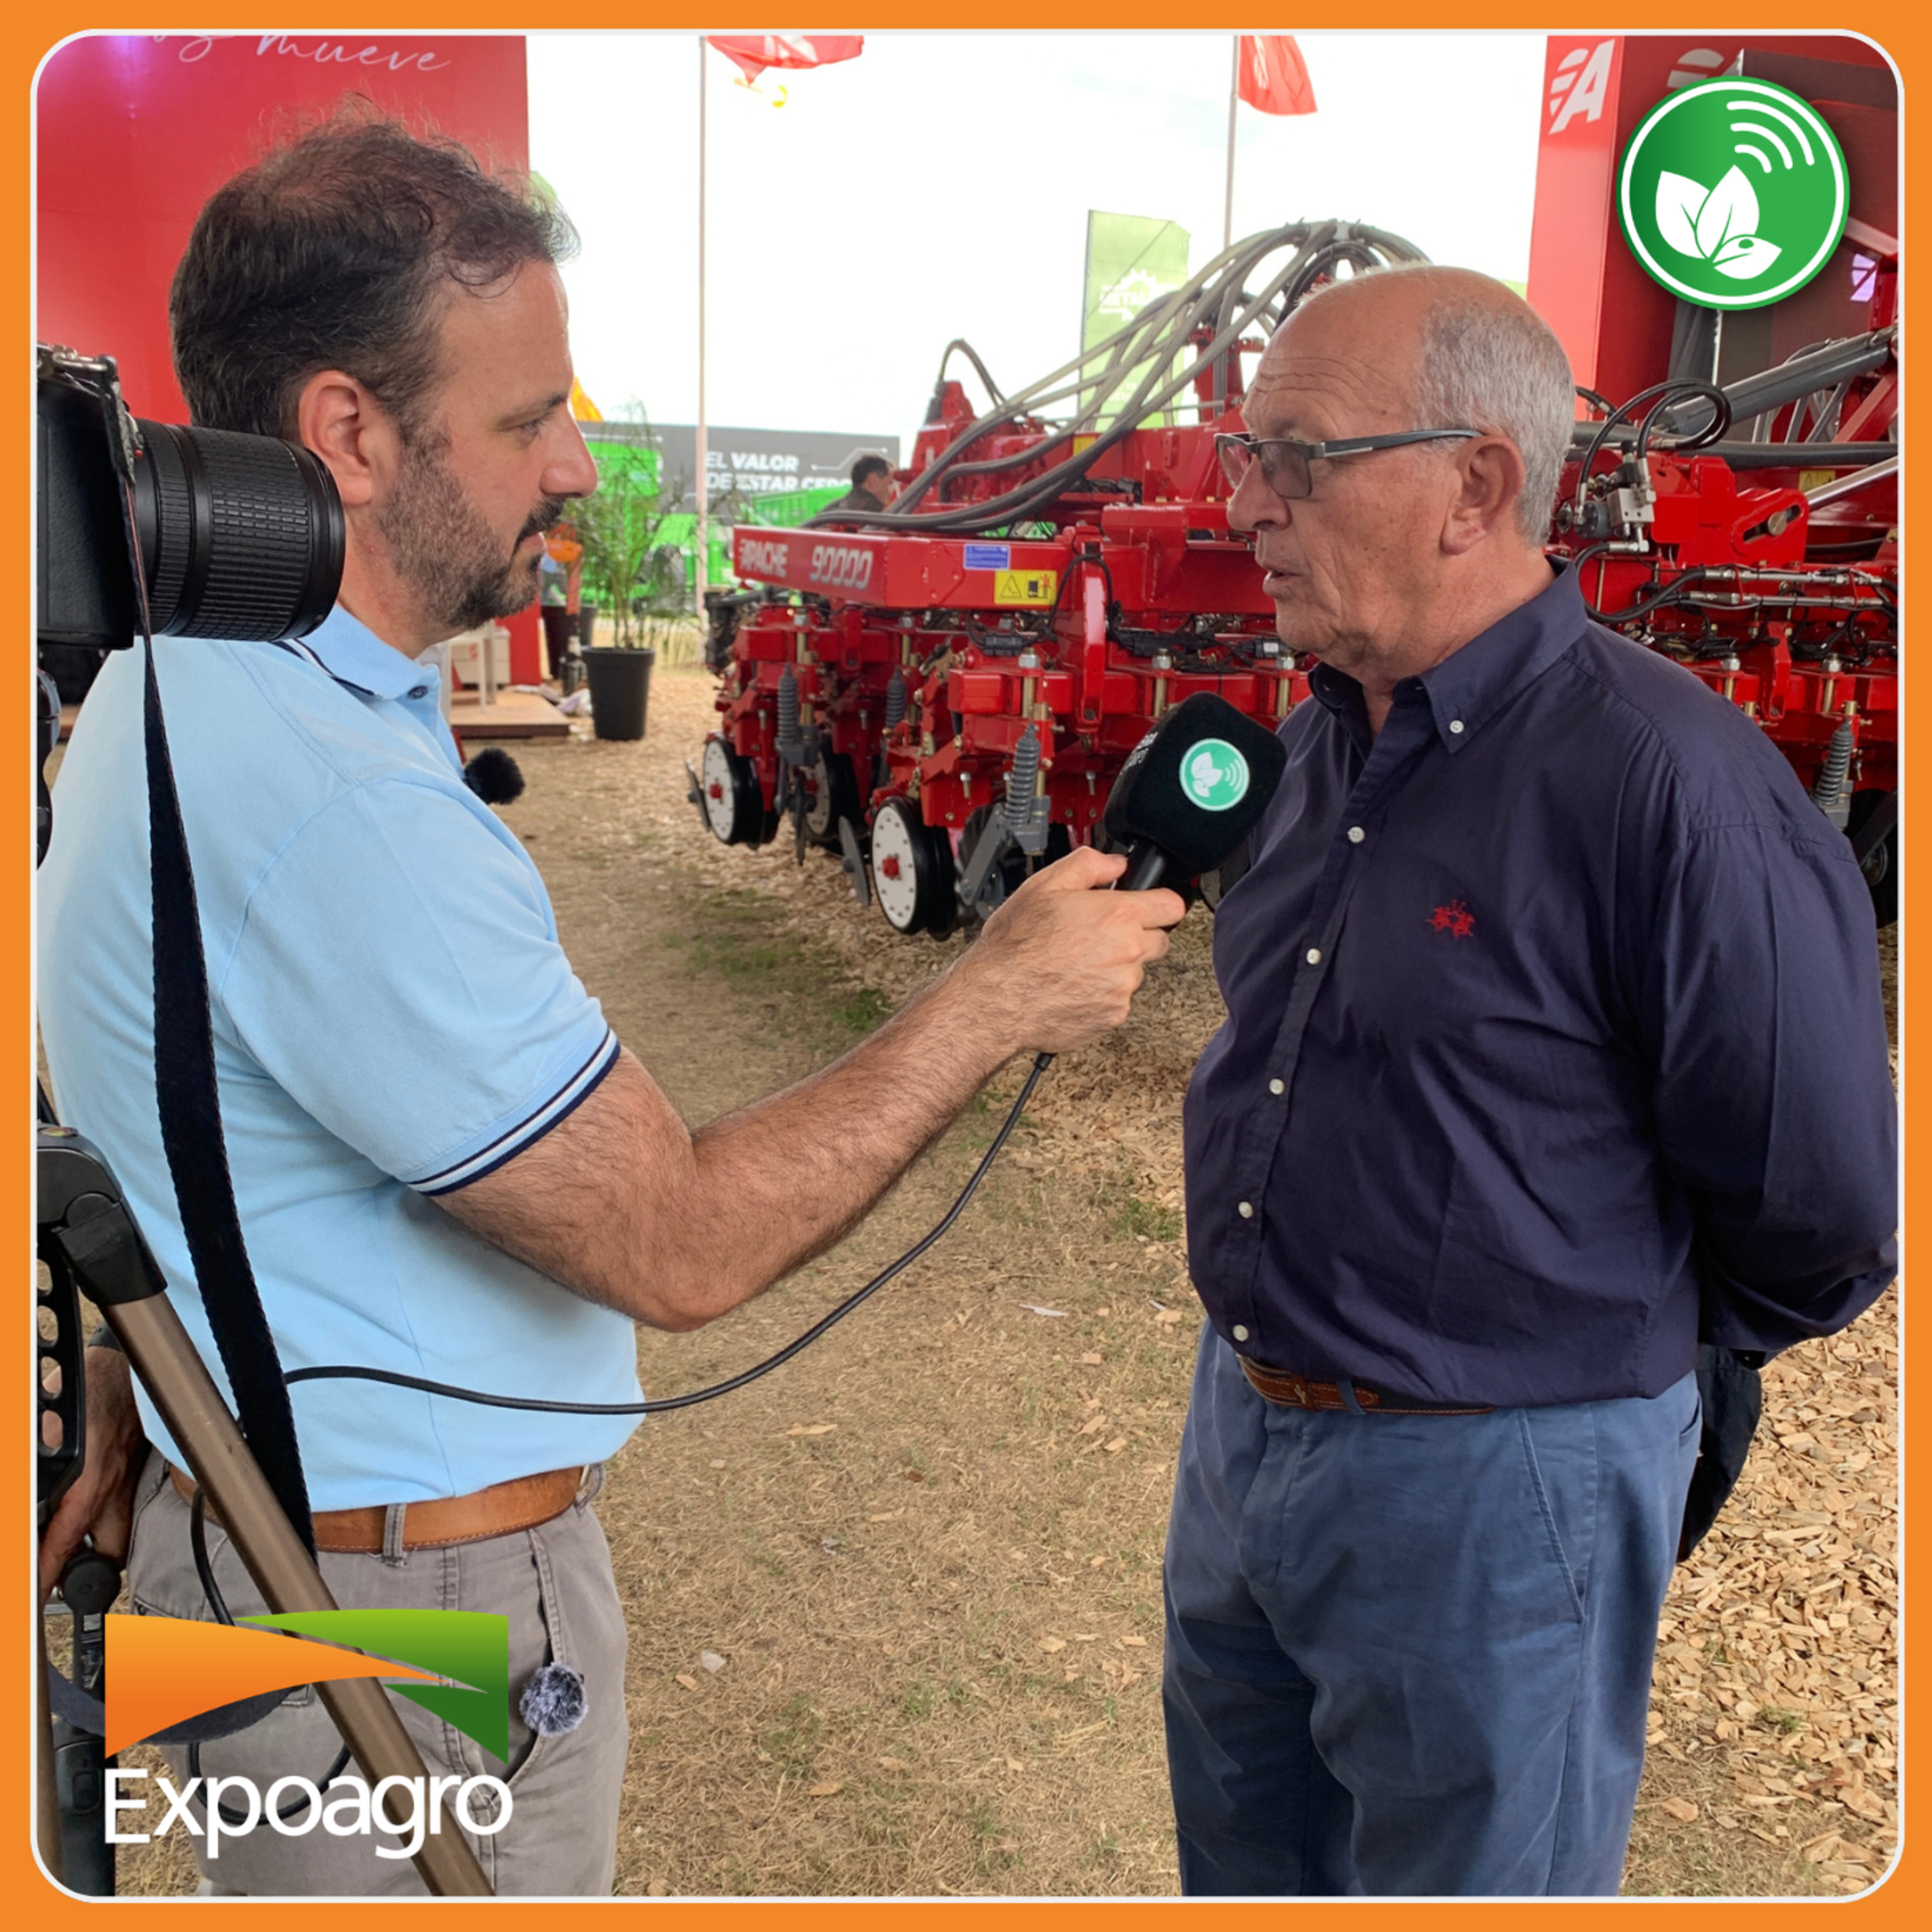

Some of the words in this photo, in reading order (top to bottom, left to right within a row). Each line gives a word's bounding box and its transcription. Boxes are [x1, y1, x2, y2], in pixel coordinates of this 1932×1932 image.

[706, 451, 727, 469] EL
[730, 452, 800, 472] VALOR
[706, 471, 733, 490] DE
[735, 474, 798, 492] ESTAR
